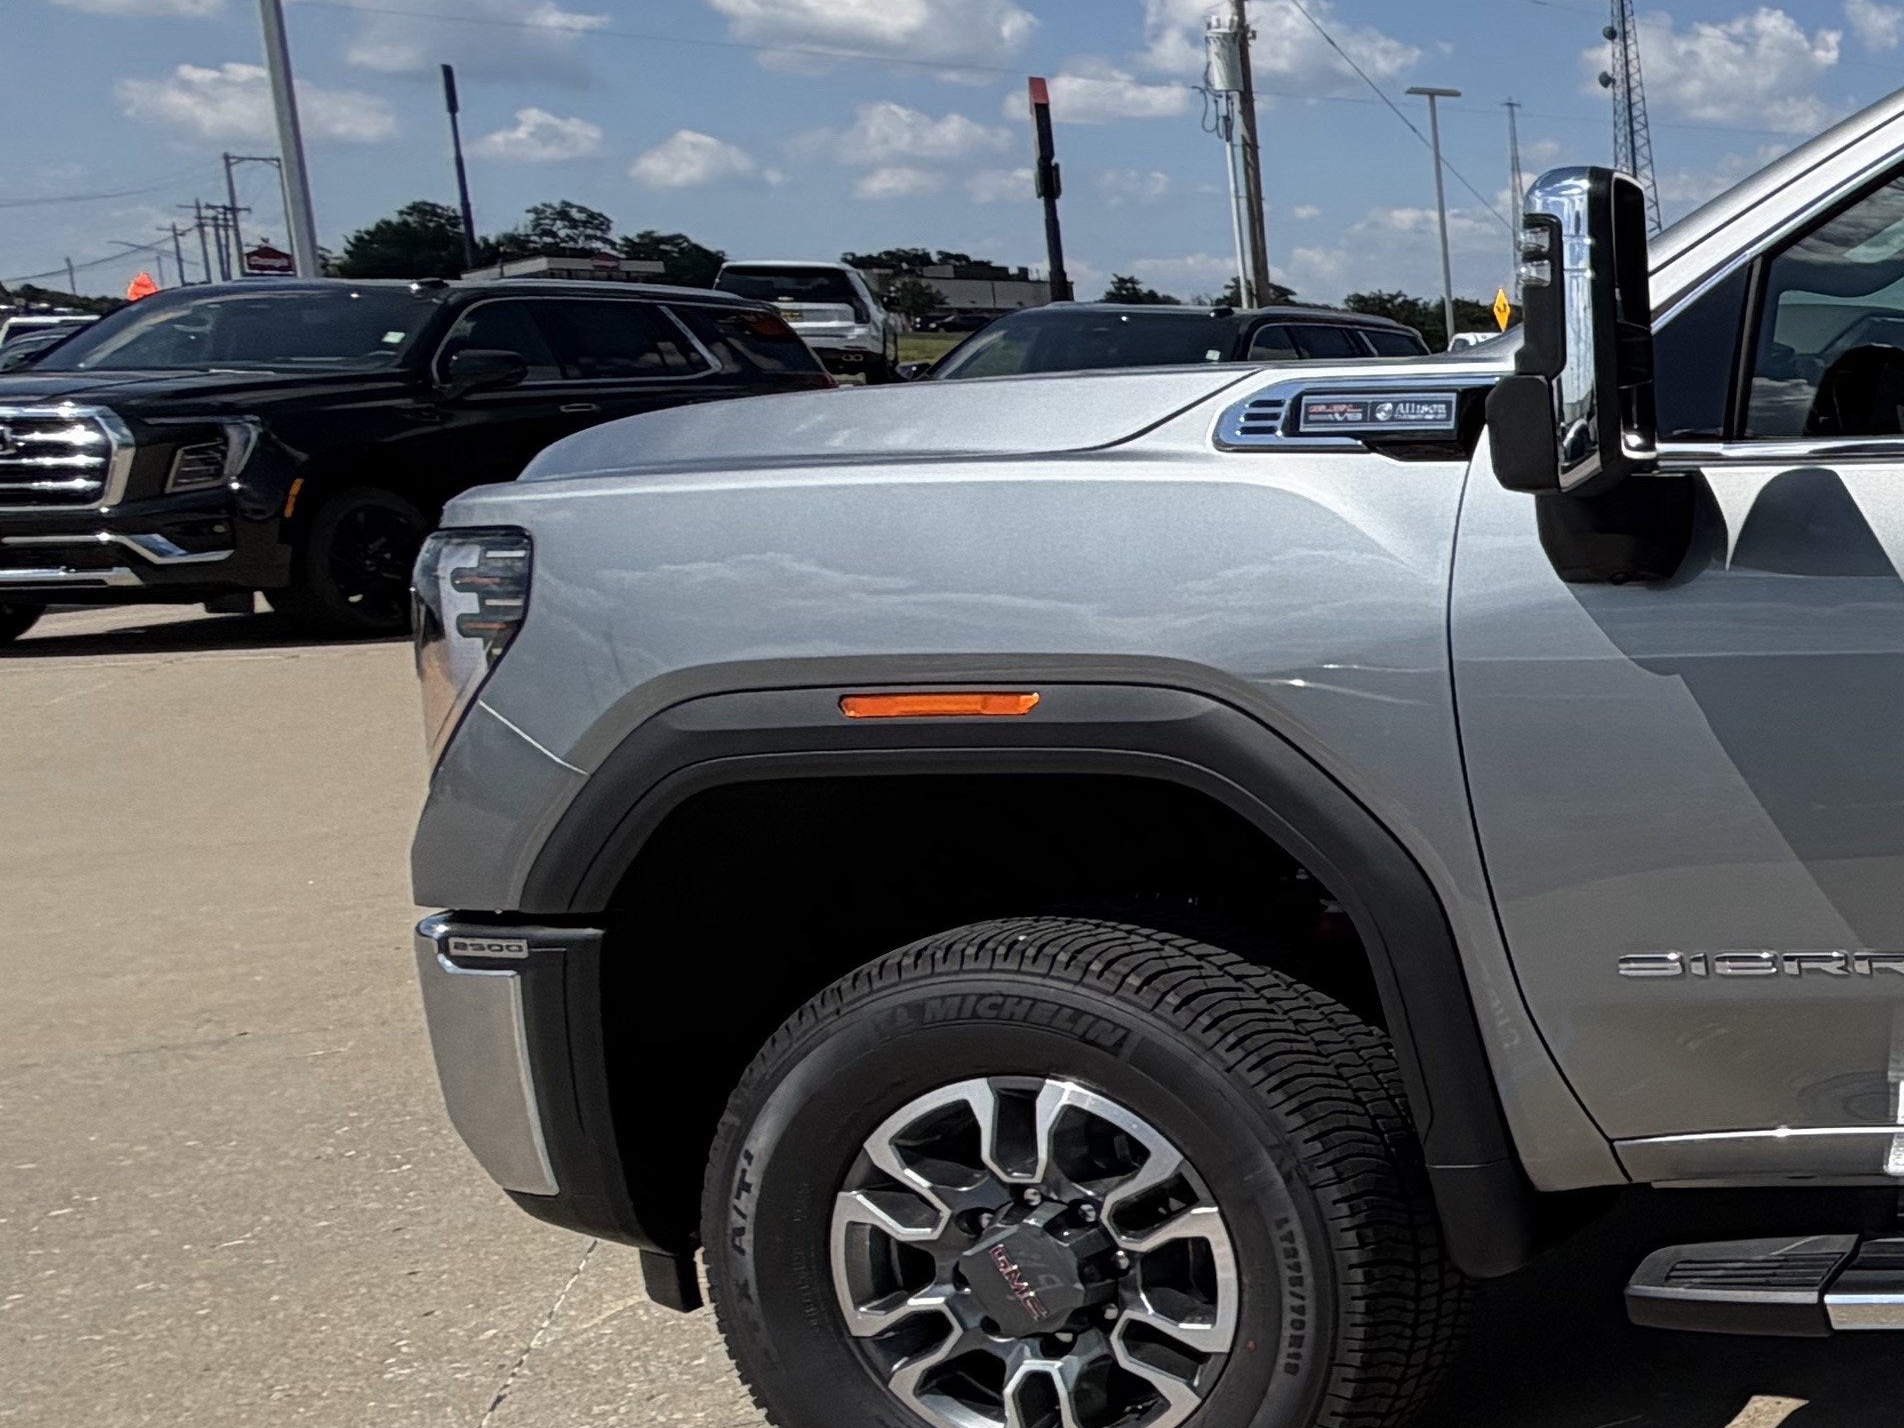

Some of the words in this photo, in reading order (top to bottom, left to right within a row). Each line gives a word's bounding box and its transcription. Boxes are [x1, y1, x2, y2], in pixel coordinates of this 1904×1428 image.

[453, 941, 524, 953] 2500
[921, 993, 1129, 1051] MICHELIN
[988, 1242, 1050, 1322] GMC
